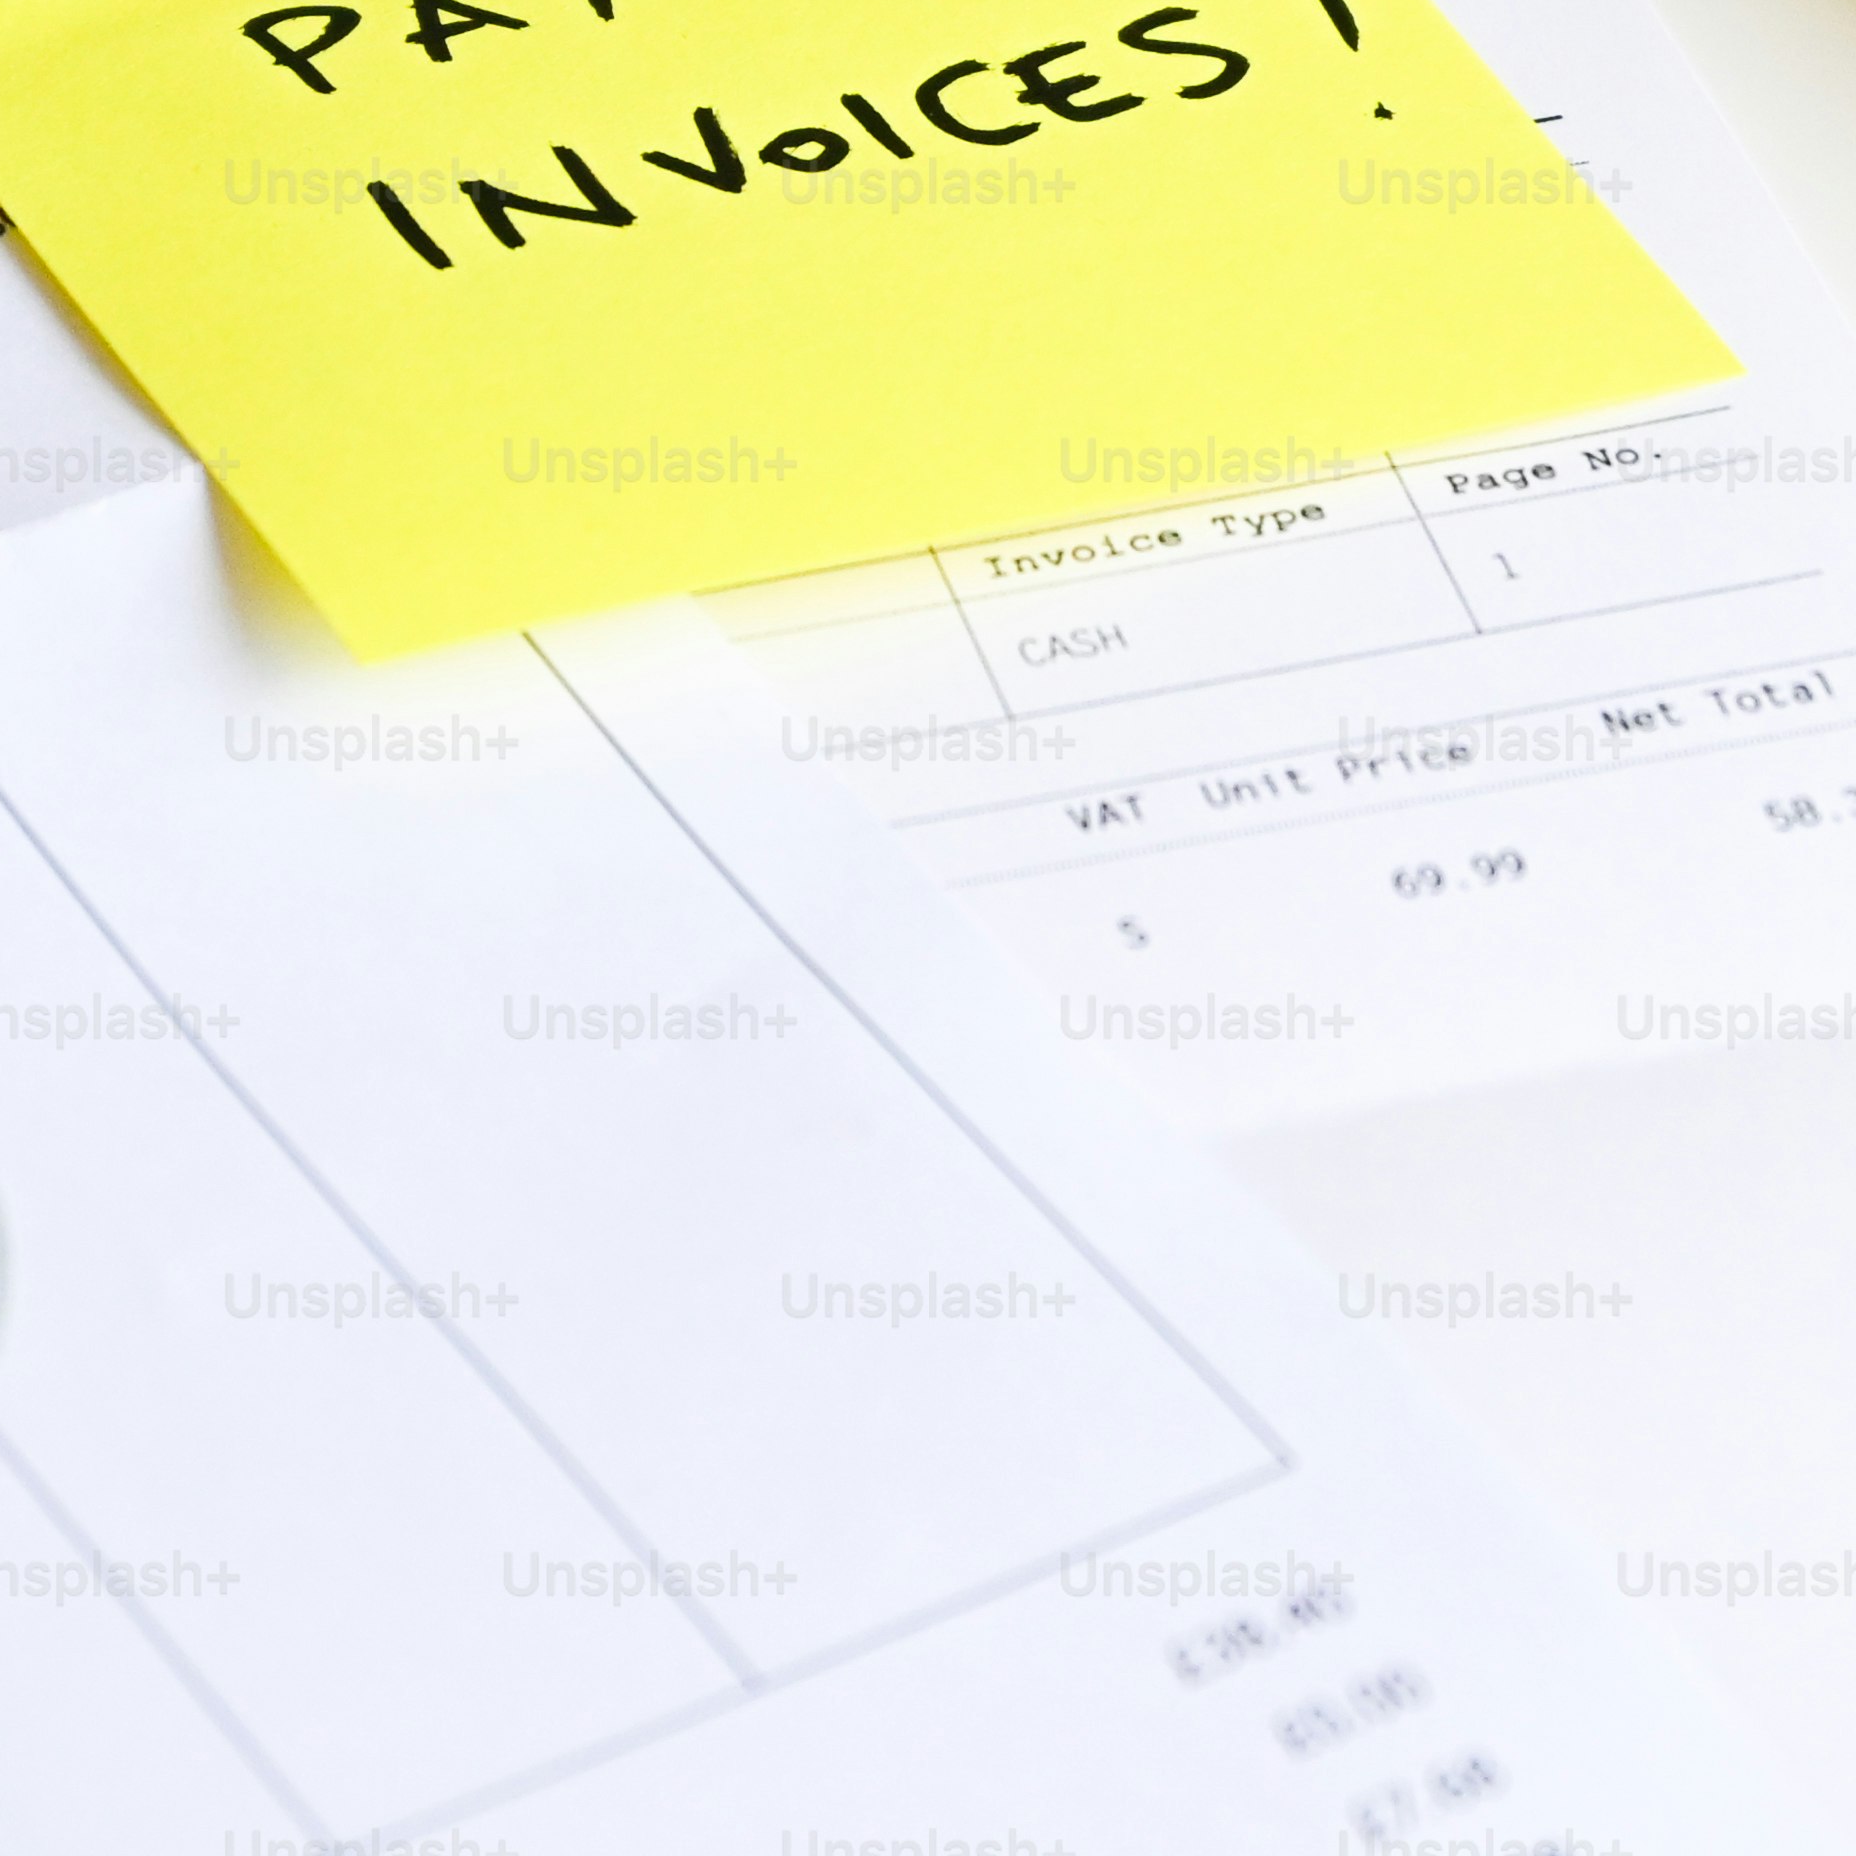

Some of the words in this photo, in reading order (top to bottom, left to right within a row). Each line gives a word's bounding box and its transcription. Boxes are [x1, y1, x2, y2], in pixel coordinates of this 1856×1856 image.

[984, 527, 1183, 580] Invoice
[1209, 501, 1326, 539] Type
[1443, 461, 1558, 495] Page
[1581, 445, 1665, 472] No.
[1016, 624, 1128, 668] CASH
[1065, 793, 1147, 837] VAT
[1199, 767, 1312, 813] Unit
[1334, 742, 1474, 784] Price
[1601, 703, 1683, 739] Net
[1704, 670, 1836, 721] Total
[1391, 847, 1529, 899] 69.99
